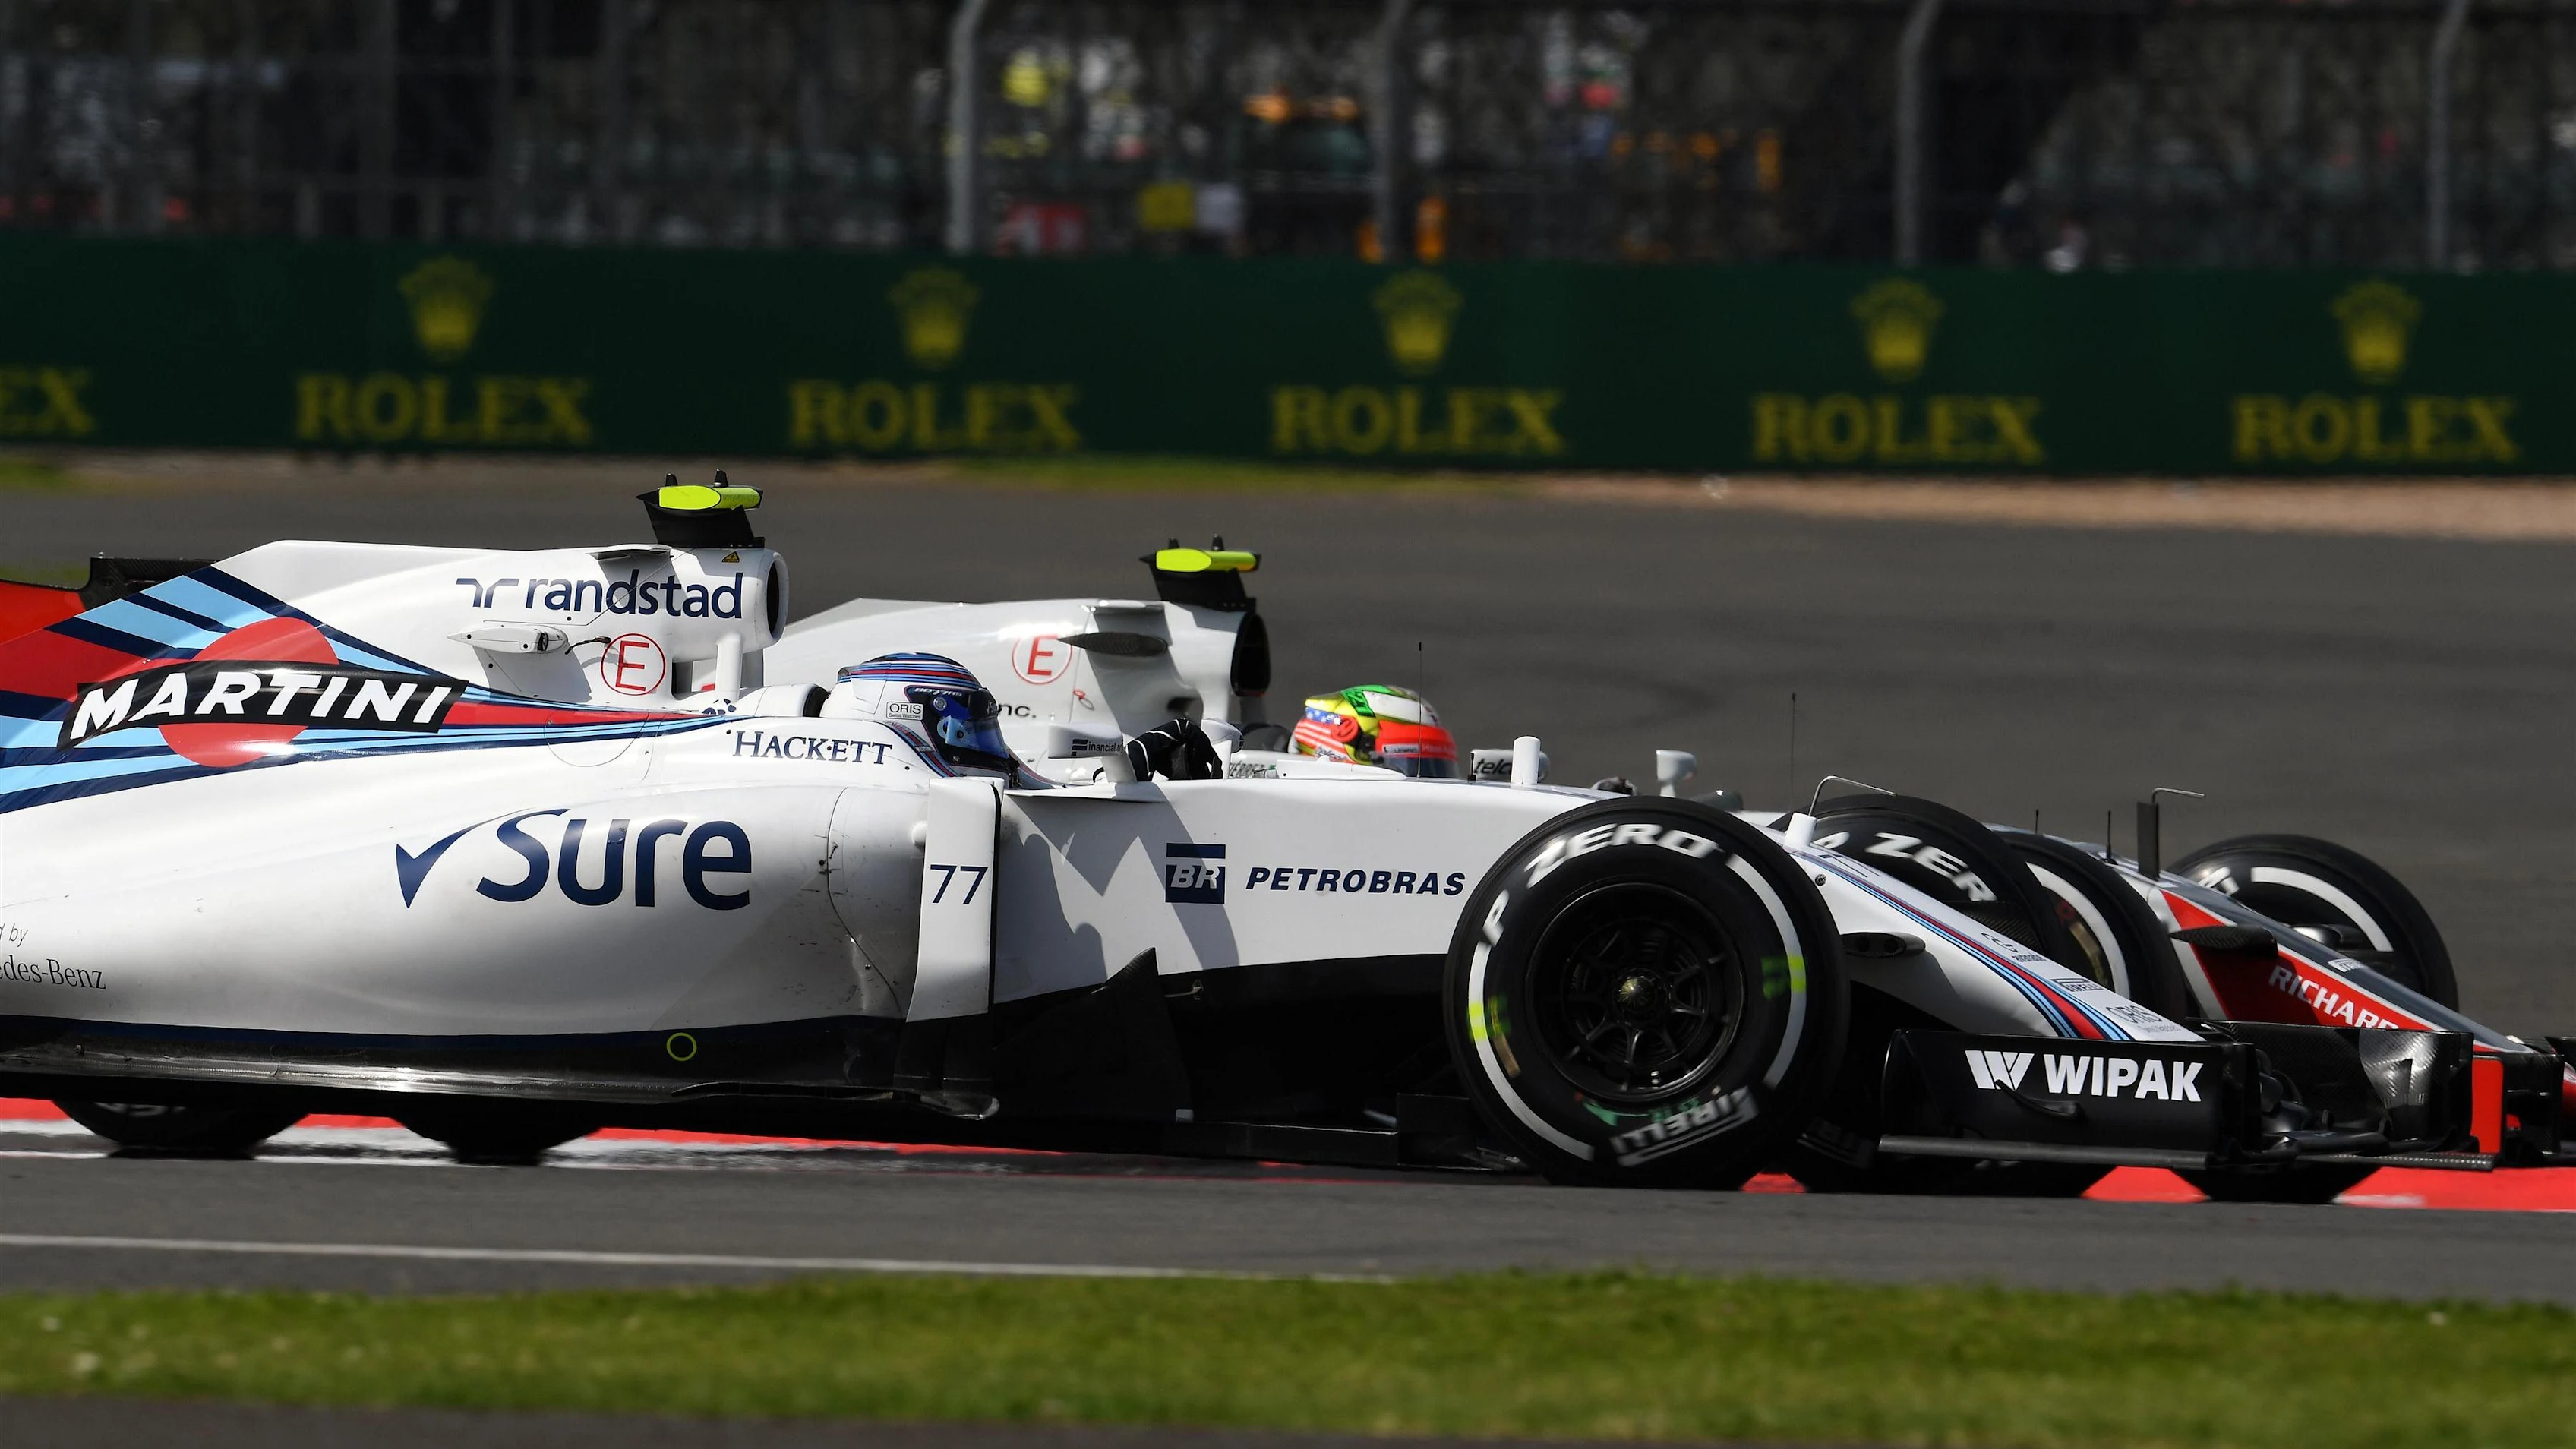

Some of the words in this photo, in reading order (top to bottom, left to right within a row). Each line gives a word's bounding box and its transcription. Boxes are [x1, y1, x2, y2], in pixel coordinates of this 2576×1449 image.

[297, 373, 591, 442] ROLEX
[790, 380, 1081, 450] ROLEX
[1272, 385, 1564, 453] ROLEX
[1752, 393, 2044, 462] ROLEX
[2232, 392, 2518, 461] ROLEX
[526, 569, 743, 619] randstad
[616, 640, 650, 692] E
[1028, 635, 1059, 675] E
[69, 668, 454, 740] MARTINI
[889, 703, 922, 715] ORIS
[997, 704, 1036, 718] nc.
[732, 730, 893, 765] HACKETT
[1474, 759, 1512, 774] telc
[476, 808, 752, 911] Sure
[1170, 864, 1220, 889] BR
[1523, 822, 1724, 889] ZERO
[1864, 832, 1998, 902] ZER
[929, 863, 989, 905] 77
[1245, 866, 1467, 897] PETROBRAS
[9, 923, 29, 948] by
[0, 954, 106, 990] des-Benz
[2105, 1005, 2163, 1024] ORIS
[2268, 965, 2399, 1030] RICHAR
[2043, 1053, 2203, 1102] WIPAK
